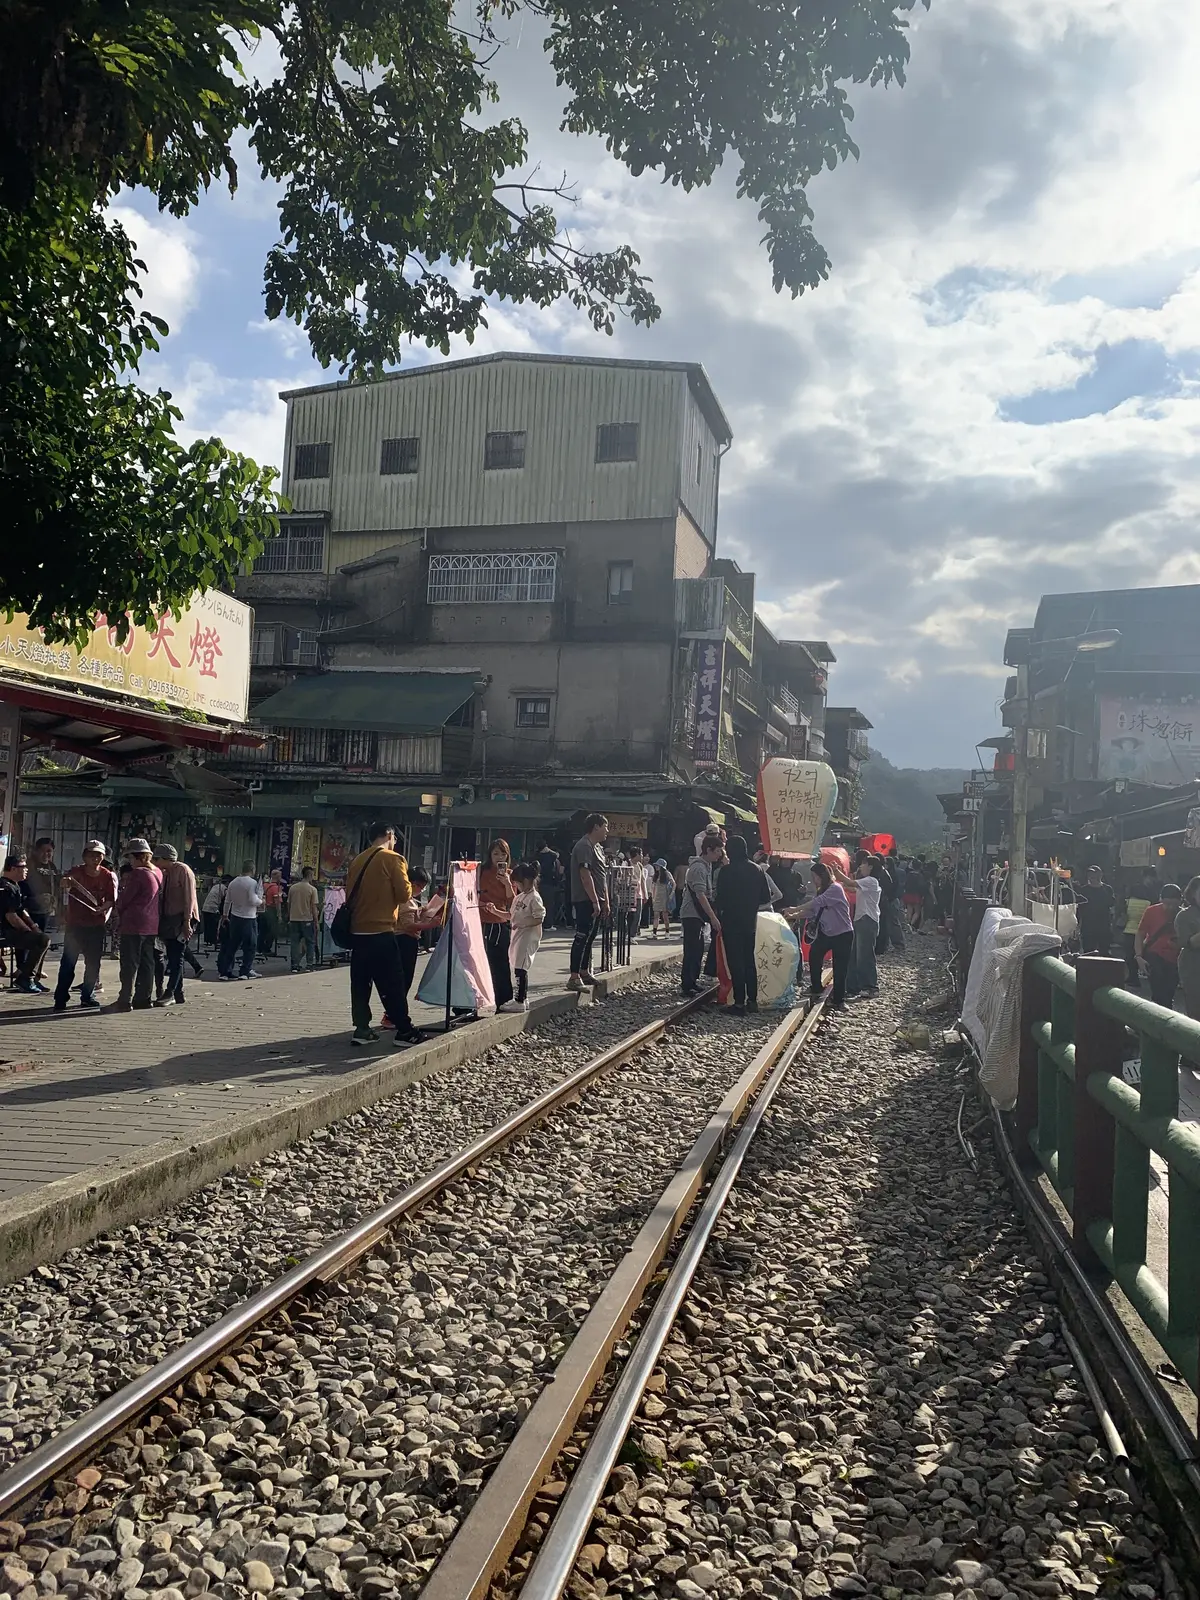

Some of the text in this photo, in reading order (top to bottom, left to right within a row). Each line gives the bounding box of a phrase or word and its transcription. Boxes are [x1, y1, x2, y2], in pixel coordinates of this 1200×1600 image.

[77, 655, 124, 683] 各種飾品
[696, 644, 717, 740] 吉祥天燈
